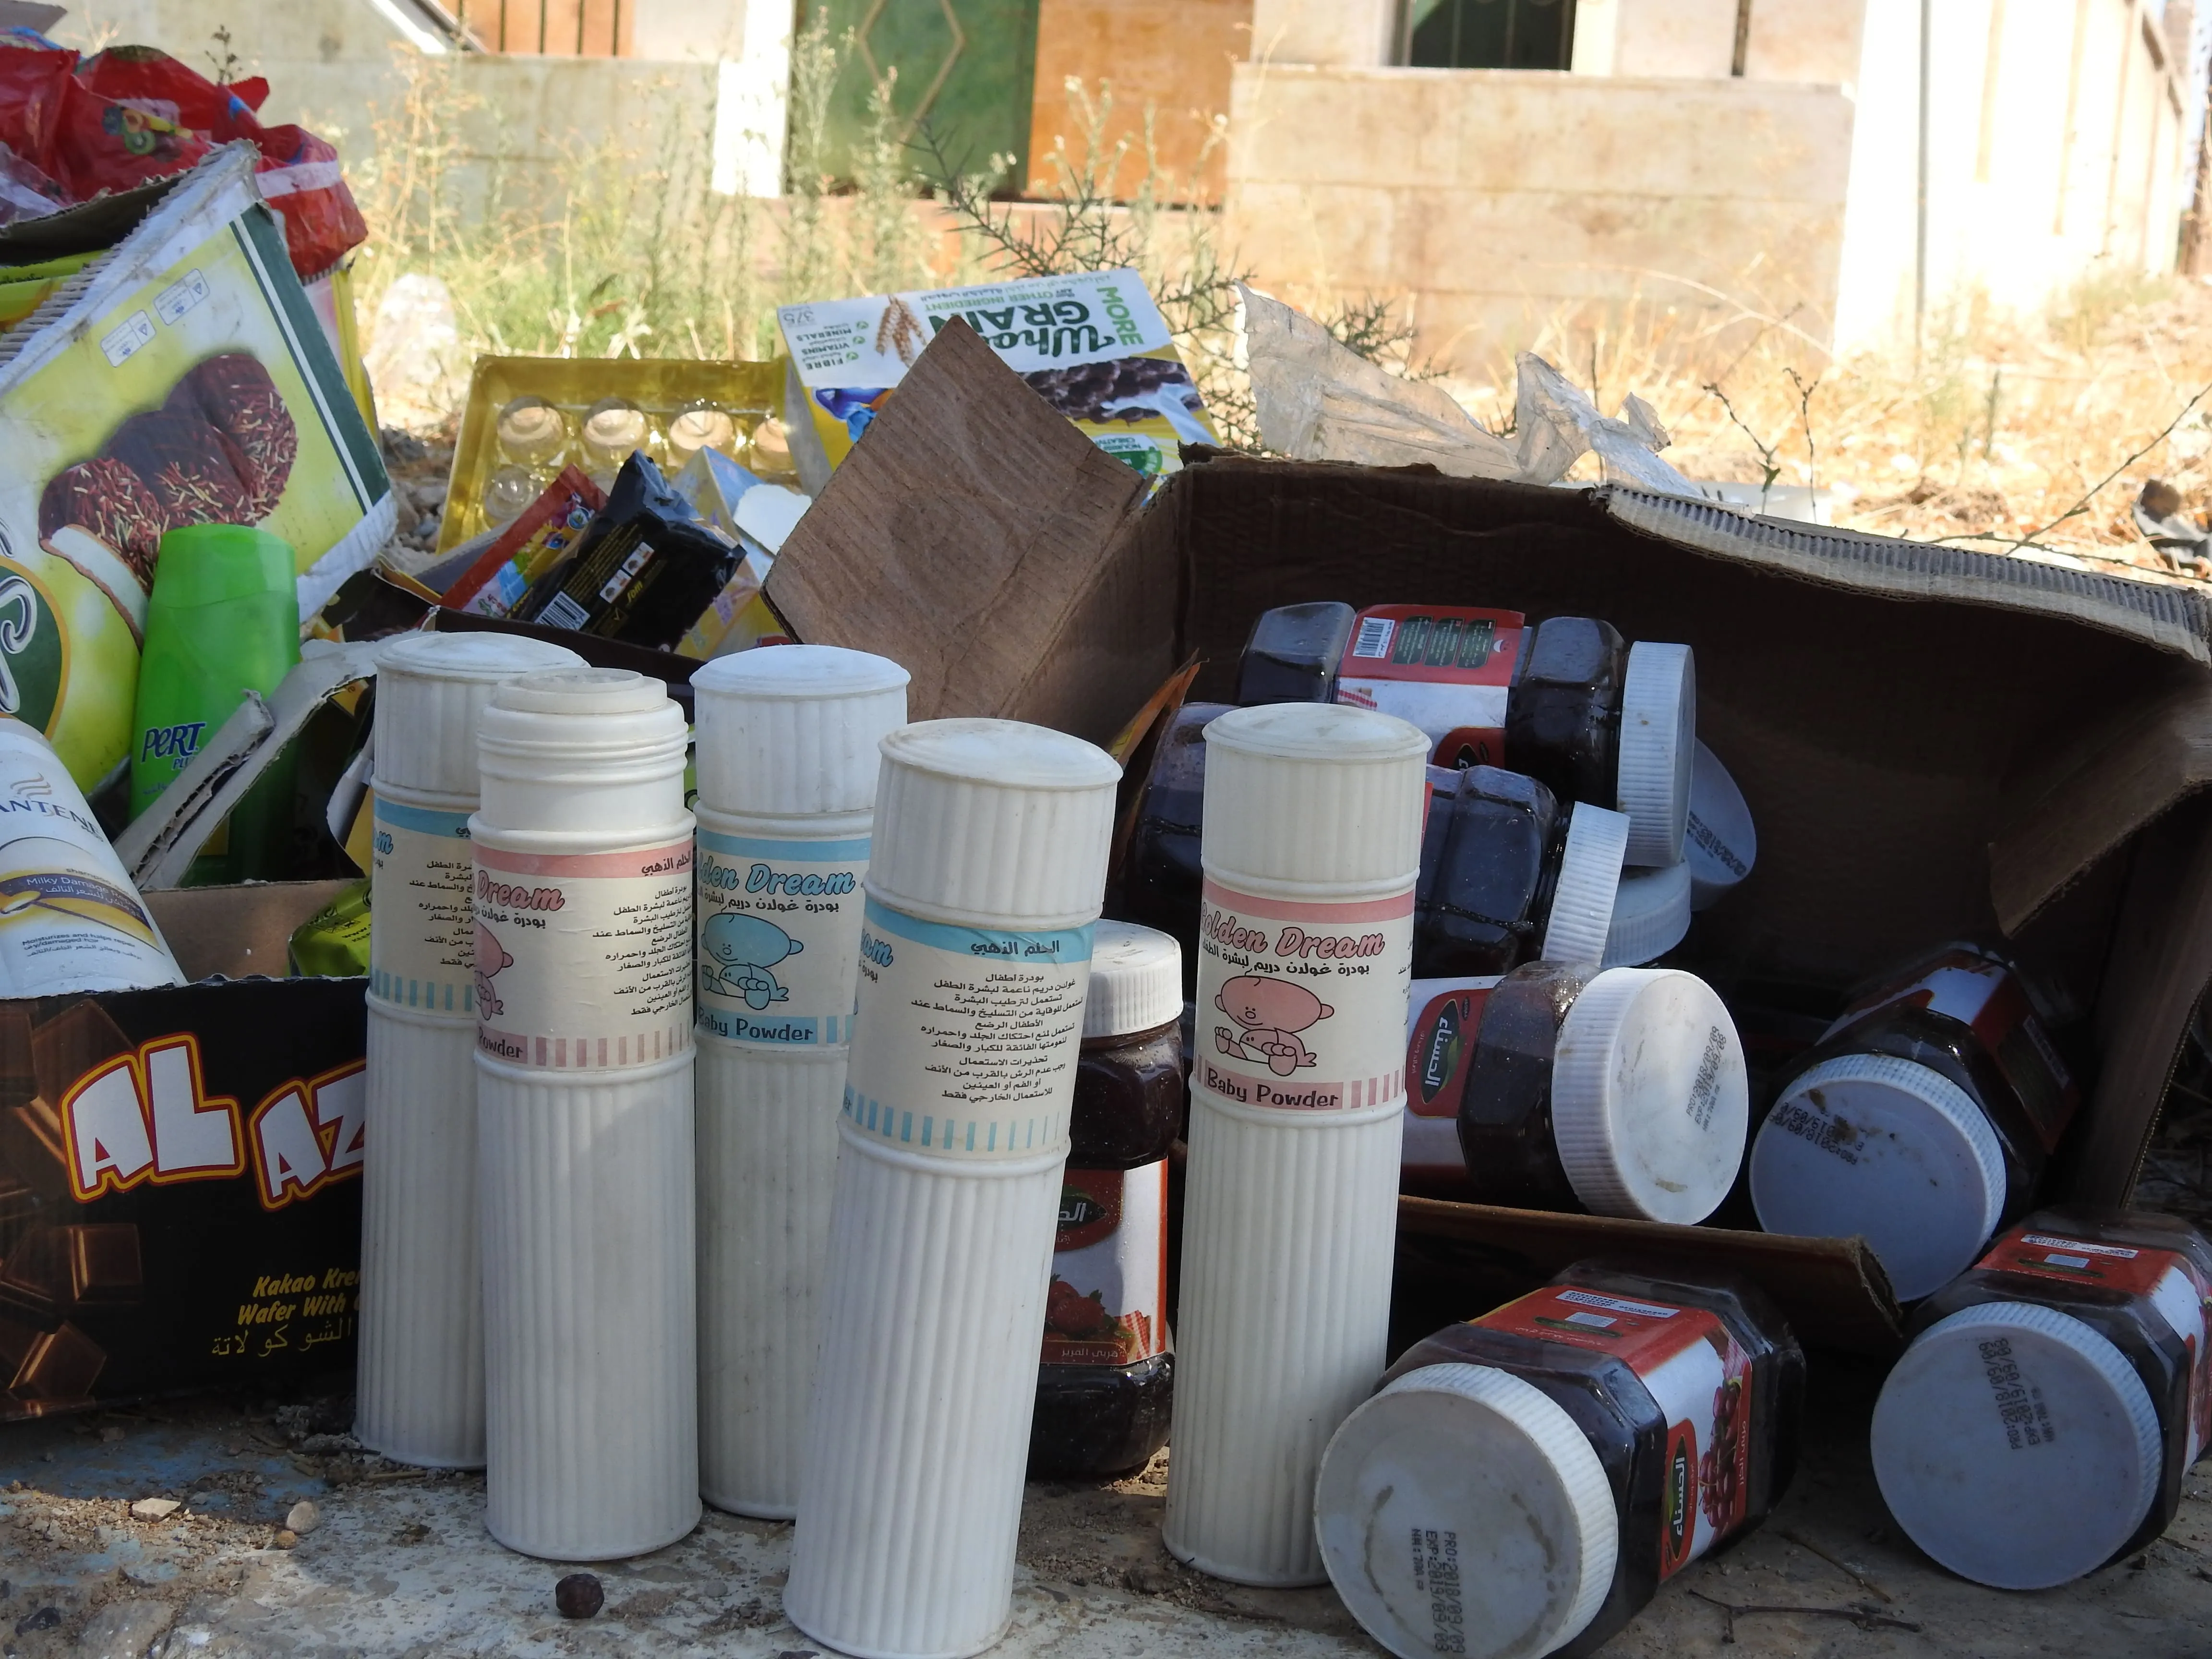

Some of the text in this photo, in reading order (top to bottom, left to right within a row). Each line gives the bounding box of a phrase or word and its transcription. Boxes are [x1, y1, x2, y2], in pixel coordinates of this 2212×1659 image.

[924, 293, 1054, 312] OTHER INGREDIENT
[1097, 287, 1144, 345] MORE
[795, 328, 852, 342] MINERALS
[982, 325, 1115, 357] Who
[801, 342, 850, 356] VITAMINS
[805, 358, 843, 371] FIBRE
[426, 861, 454, 870] الطفل
[641, 857, 673, 877] الذهبي
[445, 872, 472, 881] لبشرة
[745, 863, 856, 896] Dream
[26, 877, 58, 886] Milky
[61, 877, 110, 894] Damage
[409, 880, 465, 893] والسماط عند
[477, 870, 565, 911] Dream
[419, 902, 458, 913] واحمراره
[613, 905, 641, 915] الطفل
[643, 901, 665, 912] لبشرة
[728, 898, 751, 910] دريم
[805, 899, 839, 914] بودرة
[428, 914, 464, 924] والصغار
[513, 912, 546, 929] بودرة
[633, 914, 659, 925] البشرة
[614, 927, 651, 937] والسماط
[652, 920, 677, 934] التسليخ
[22, 934, 70, 946] Moisturizes
[90, 933, 112, 941] helps
[424, 936, 447, 944] الأنف
[651, 933, 673, 946] الرضع
[1274, 926, 1386, 959] Dream
[648, 946, 666, 955] الجلد
[970, 939, 1060, 957] الحلم الذهبي
[605, 950, 646, 961] واحمراره
[652, 955, 672, 967] للكبار
[1222, 948, 1250, 969] لبشرة
[616, 961, 650, 971] والصغار
[1253, 961, 1280, 974] دريم
[1337, 962, 1370, 977] بودرة
[642, 967, 674, 982] الاستعمال
[1018, 974, 1044, 983] بودرة
[613, 985, 637, 995] الأنف
[652, 979, 675, 991] بالقرب
[933, 979, 966, 990] الطفل
[968, 983, 999, 995] لبشرة
[1002, 985, 1030, 994] ناعمة
[1032, 985, 1054, 995] دريم
[647, 990, 672, 1004] العينين
[911, 998, 931, 1009] عند
[954, 993, 1062, 1007] تستعمل لترطيب البشرة
[630, 998, 678, 1016] الخارجي فقط
[933, 1002, 976, 1017] والسماط
[978, 1008, 1017, 1018] التسليخ
[1019, 1009, 1033, 1018] من
[1035, 1005, 1062, 1017] للوقاية
[698, 1005, 814, 1041] Baby Powder
[974, 1019, 1044, 1030] الأطفال الرضع
[920, 1022, 1075, 1041] تستعمل لمنع احتكاك الجلد واحمراره
[931, 1036, 1068, 1053] لنعومتها الفائقة للكبار والصغار
[1424, 1016, 1453, 1087] الحسناء
[959, 1055, 1048, 1067] تحذيرات الاستعمال
[925, 1064, 1052, 1080] عدم الرش بالقرب من الأنف
[962, 1078, 1041, 1091] أو الفم أو العينين
[1207, 1067, 1339, 1108] Baby Powder
[941, 1087, 1053, 1104] للاستعمال الخارجي فقط
[70, 1042, 366, 1199] AL AZ
[253, 1273, 316, 1298] Kakao
[238, 1292, 346, 1325] Wafer With
[1672, 1456, 1685, 1537] الحسناء
